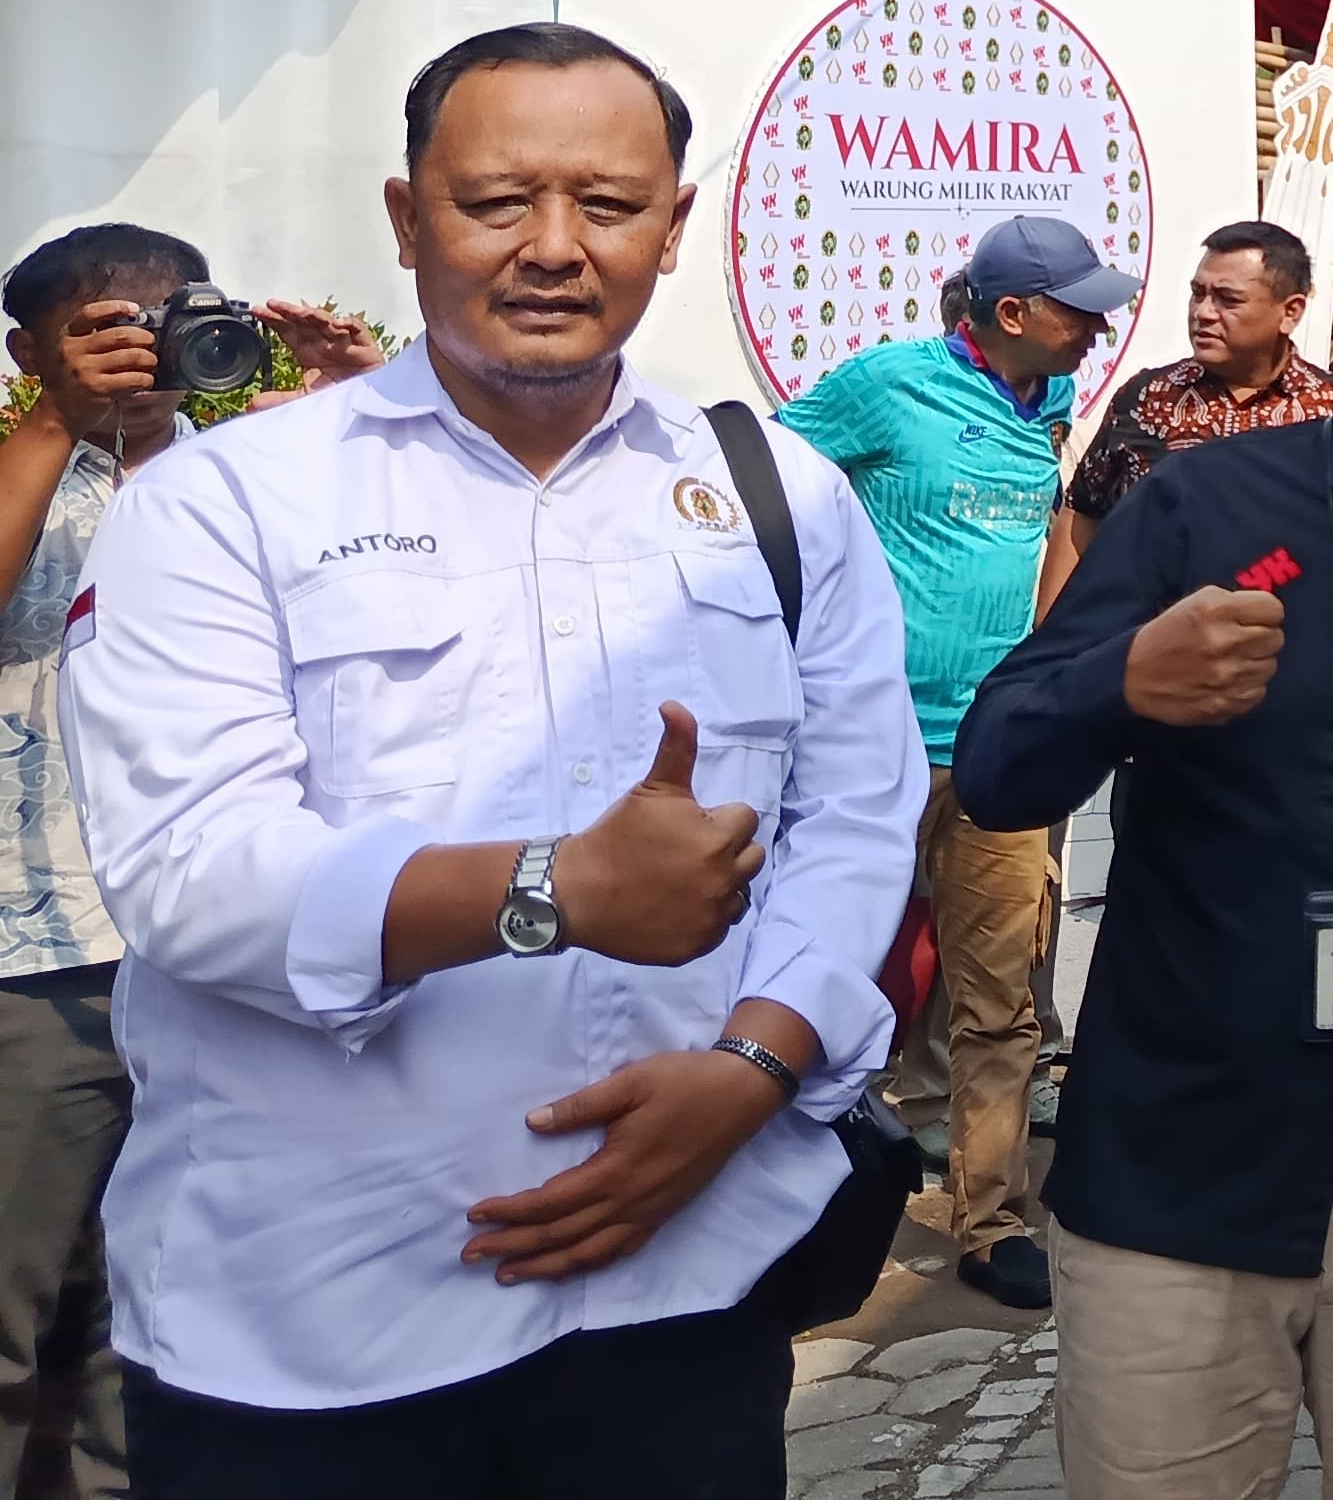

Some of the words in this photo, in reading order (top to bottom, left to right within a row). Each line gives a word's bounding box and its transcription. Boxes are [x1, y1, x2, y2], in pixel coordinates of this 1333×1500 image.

[824, 113, 1085, 174] WAMIRA
[840, 180, 933, 199] WARUNG
[938, 181, 996, 200] MILIK
[1001, 183, 1073, 201] RAKYAT
[188, 298, 222, 307] Canon
[318, 533, 437, 564] ANTORO
